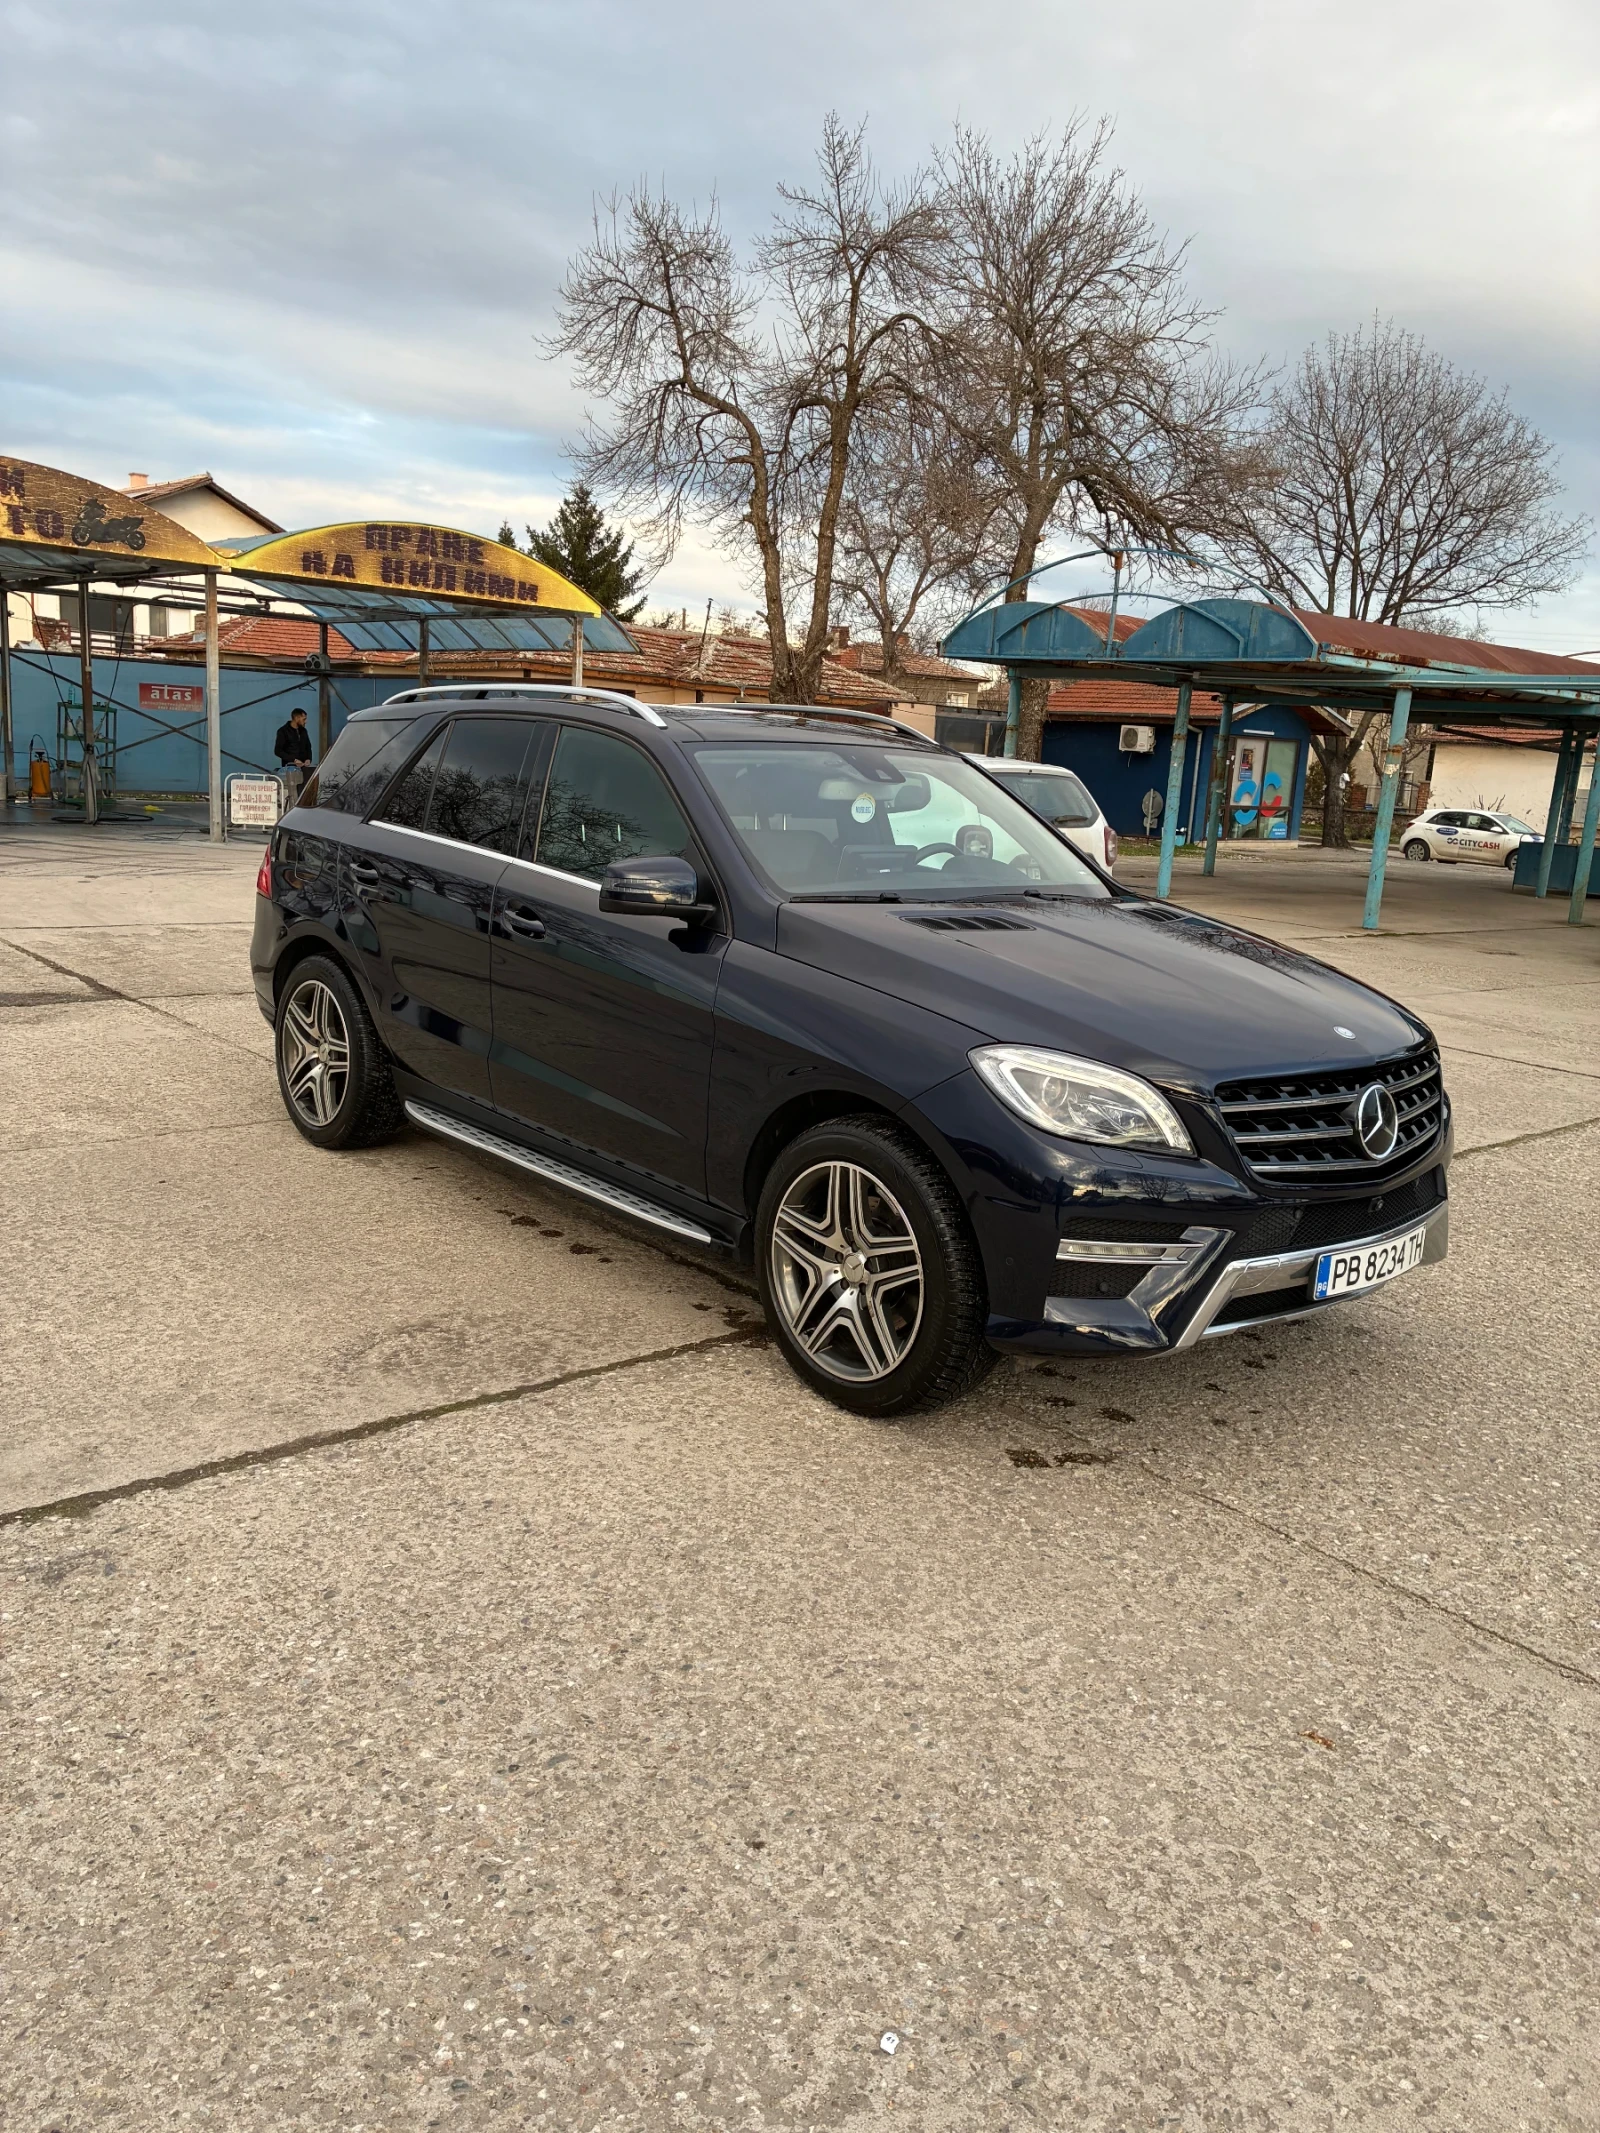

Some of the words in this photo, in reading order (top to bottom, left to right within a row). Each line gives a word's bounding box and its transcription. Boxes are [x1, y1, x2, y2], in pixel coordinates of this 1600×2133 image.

[366, 524, 484, 565] ПРАНЕ
[302, 551, 356, 579] НА
[381, 556, 539, 602] КИЛИМИ
[150, 685, 192, 701] atas
[1459, 838, 1500, 850] CITYCASH
[1331, 1255, 1361, 1290] PB
[1364, 1239, 1406, 1282] 8234
[1408, 1230, 1424, 1266] TH
[1317, 1282, 1327, 1292] BG
